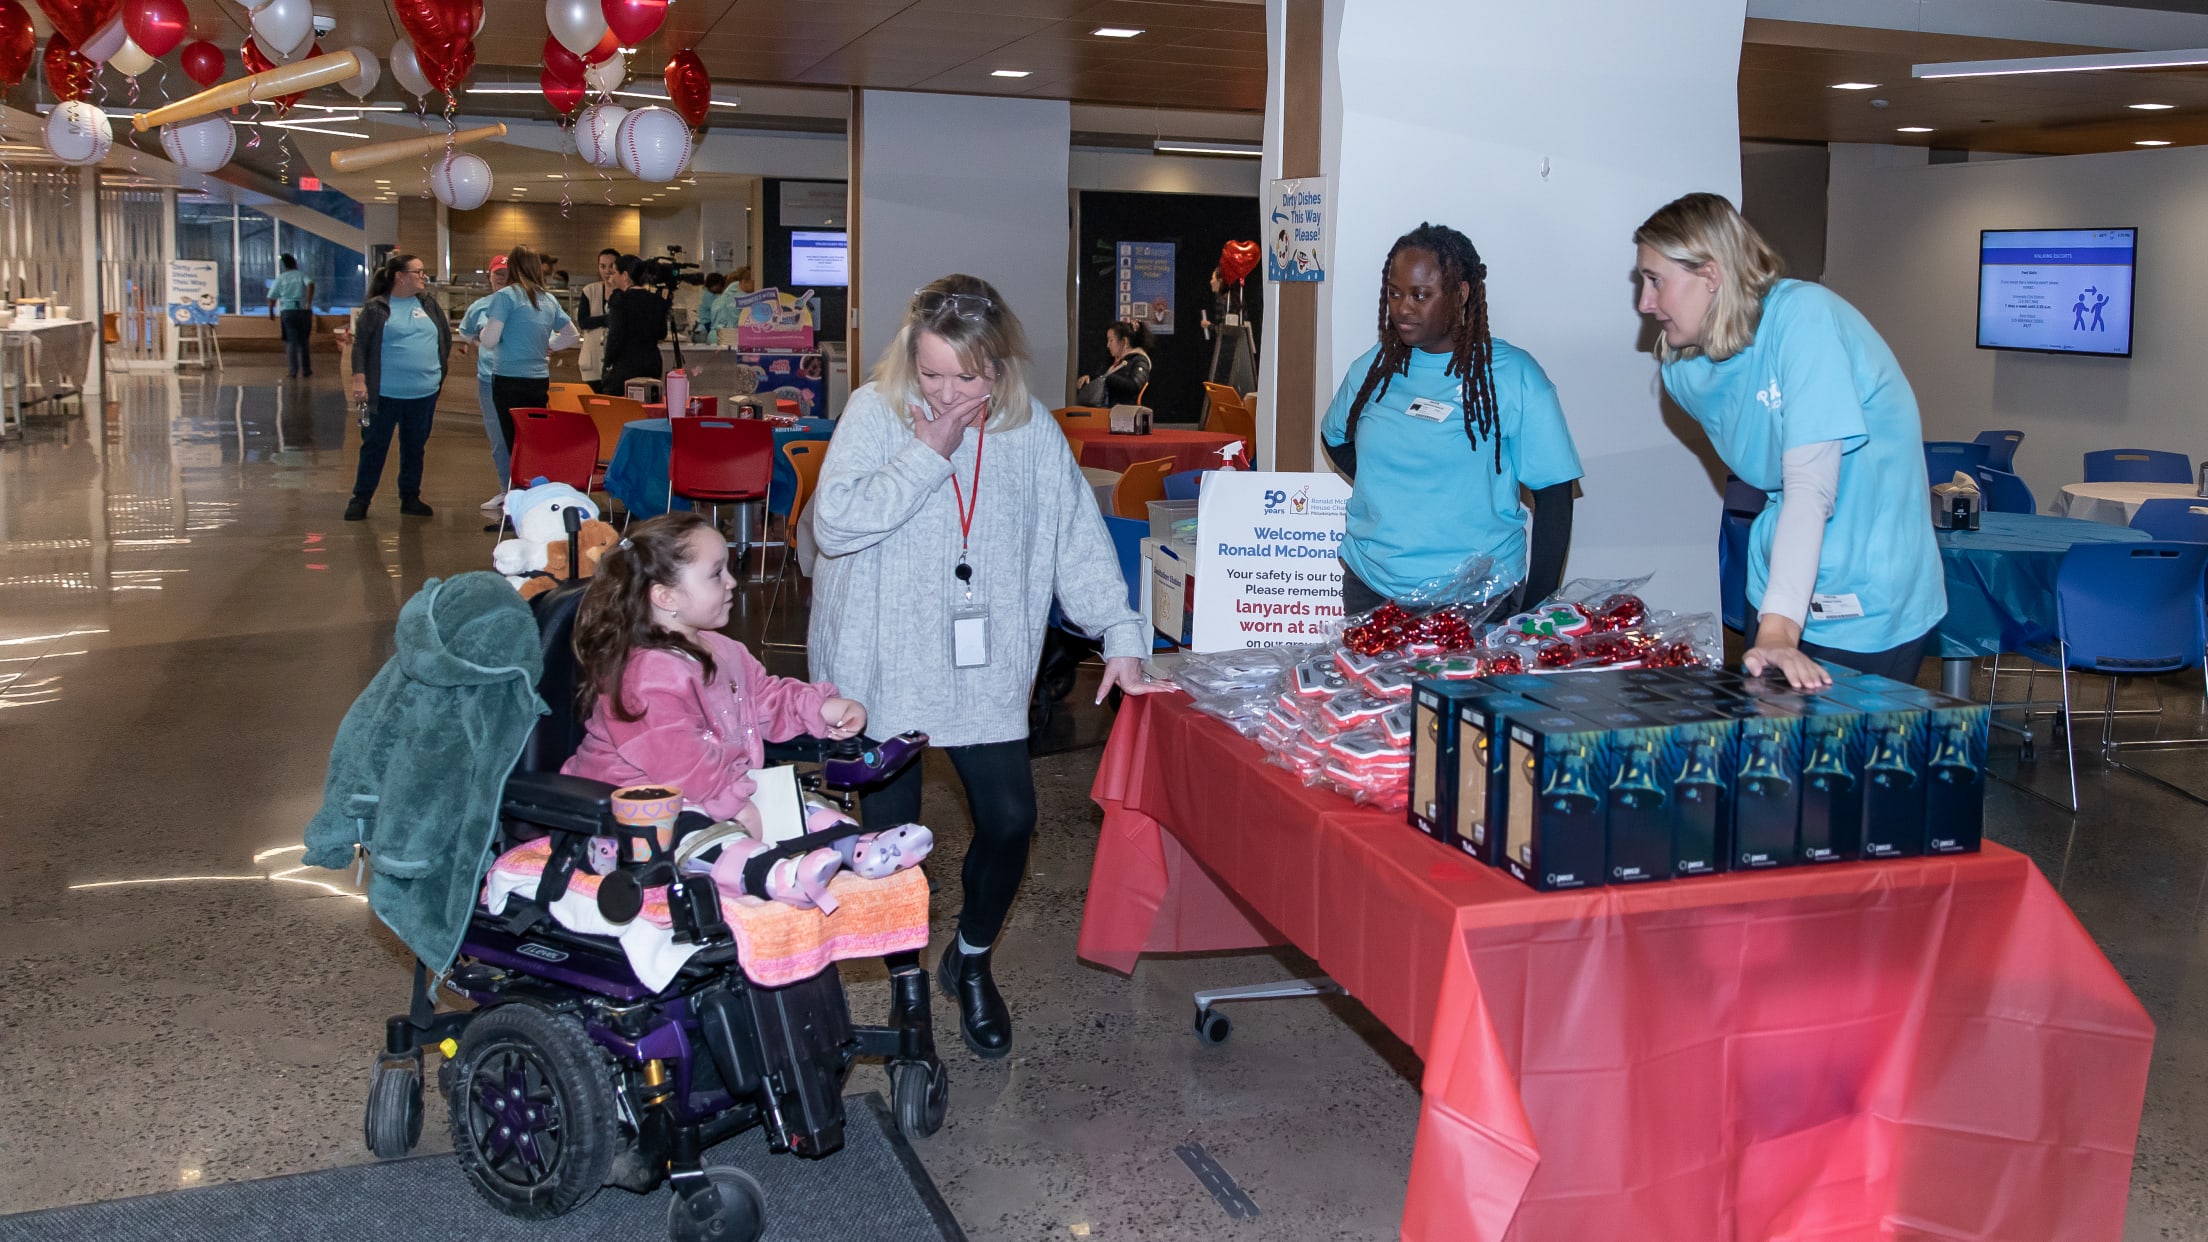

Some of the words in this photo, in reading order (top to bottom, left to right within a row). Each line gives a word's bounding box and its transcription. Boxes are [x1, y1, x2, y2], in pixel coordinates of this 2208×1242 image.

[1282, 194, 1297, 209] Dirty
[1298, 191, 1321, 206] Dishes
[1291, 210, 1304, 224] This
[1305, 209, 1321, 225] Way
[1294, 227, 1320, 242] Please!
[1264, 490, 1287, 509] 50
[1253, 527, 1326, 542] Welcome
[1330, 530, 1346, 542] to
[1218, 543, 1271, 557] Ronald
[1226, 569, 1253, 580] Your
[1256, 571, 1292, 583] safety
[1295, 571, 1304, 581] is
[1307, 573, 1327, 581] our
[1245, 585, 1285, 595] Please
[1236, 599, 1310, 618] lanyards
[1240, 621, 1282, 633] worn
[1287, 621, 1304, 634] at
[1246, 640, 1261, 648] on
